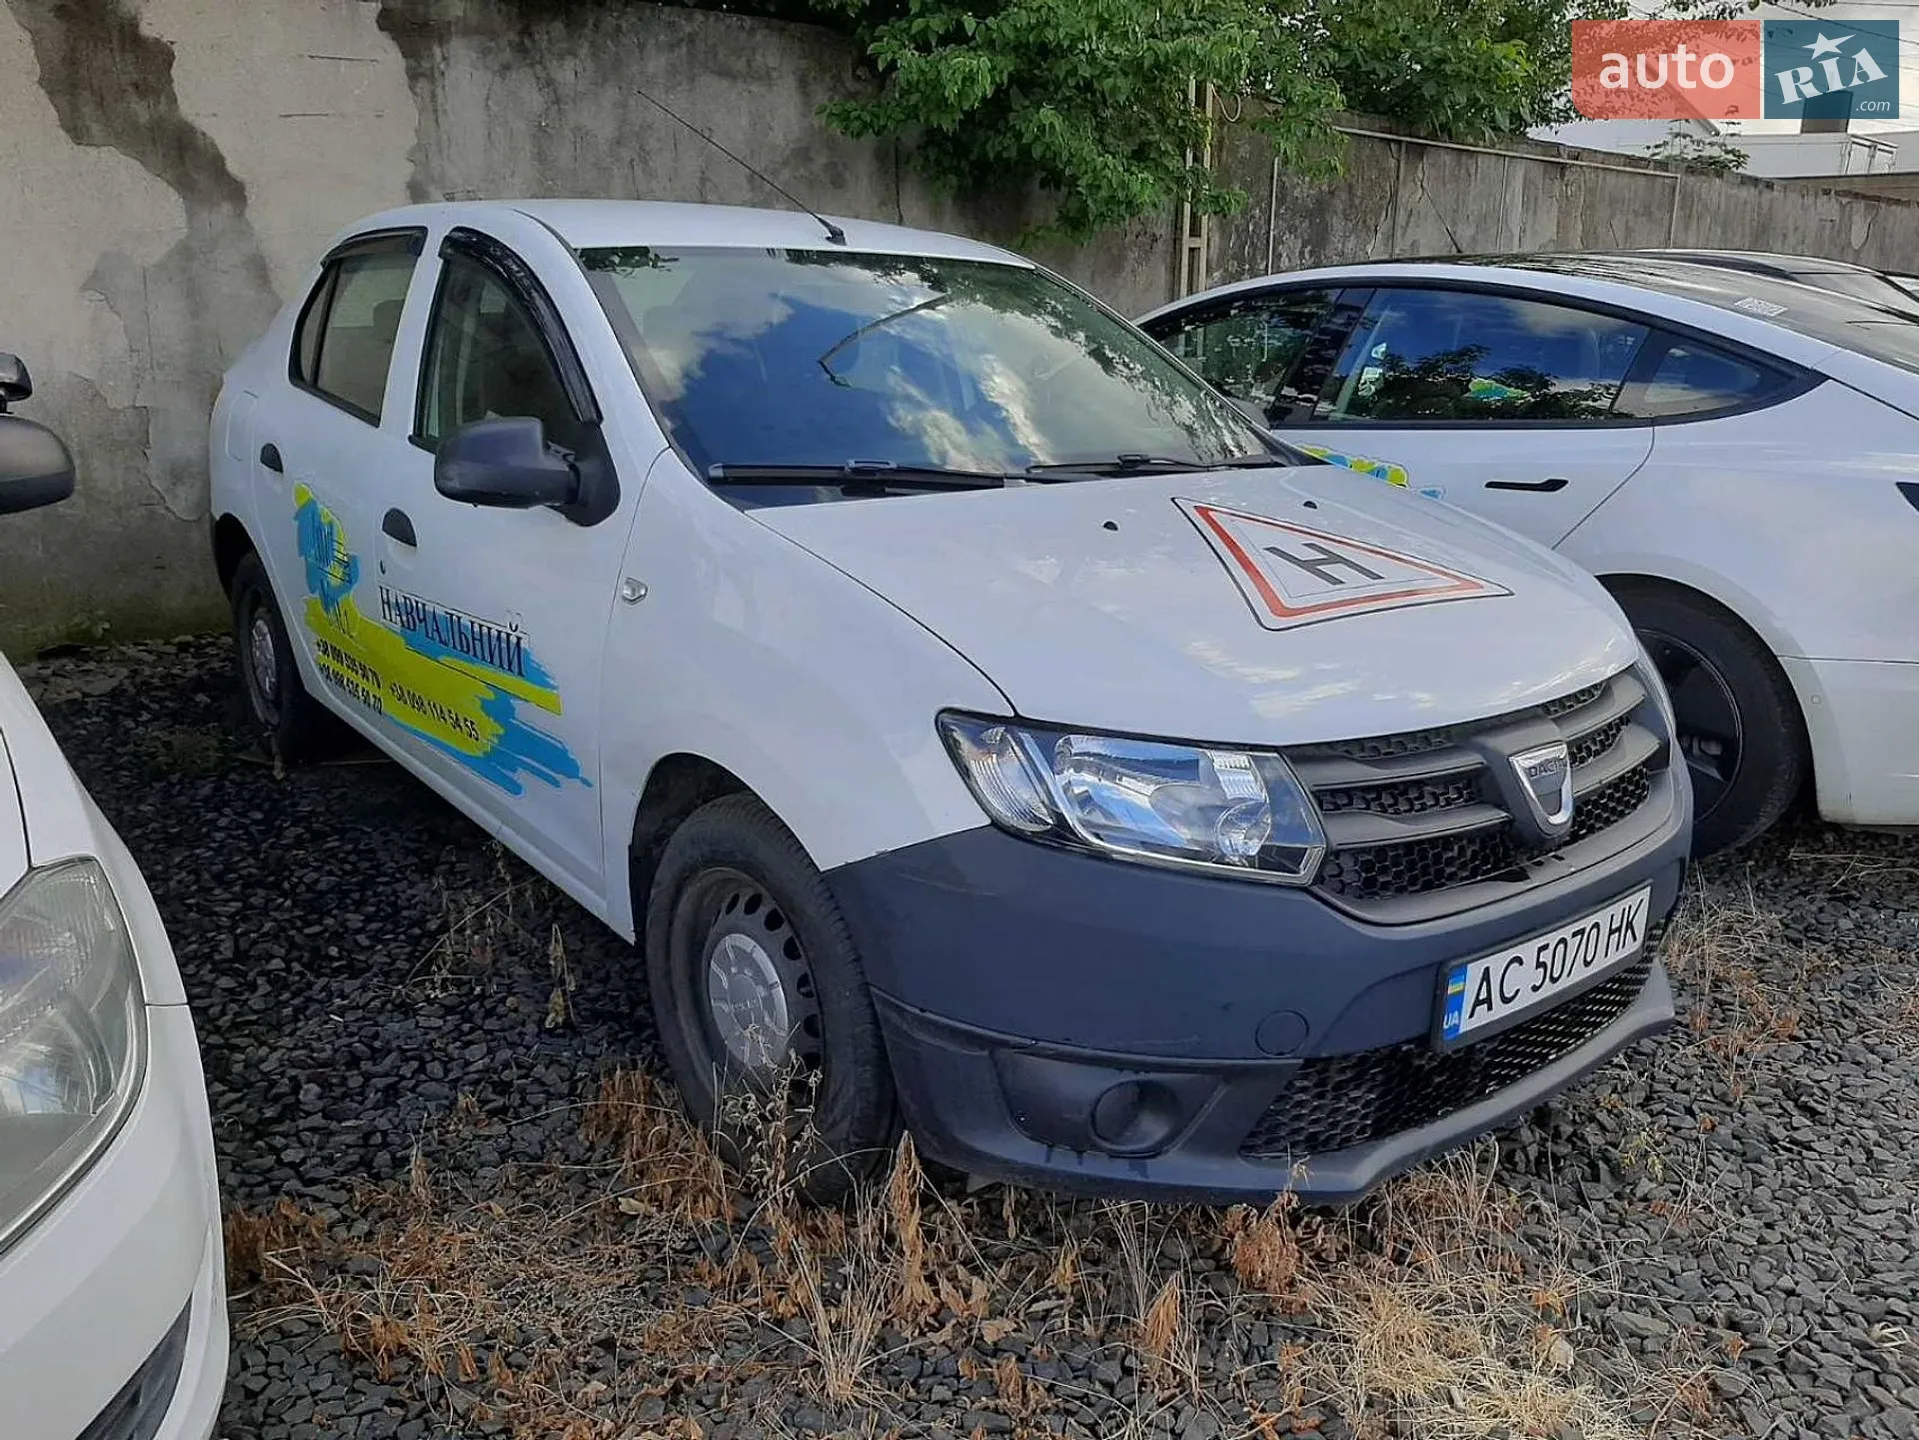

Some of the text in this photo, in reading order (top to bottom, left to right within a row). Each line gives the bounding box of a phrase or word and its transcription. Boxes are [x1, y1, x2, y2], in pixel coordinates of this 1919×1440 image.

[379, 585, 525, 677] НАВЧАЛЬНИЙ
[463, 716, 480, 742] 55
[1468, 898, 1644, 1019] AC 5070 HK
[1443, 1010, 1460, 1030] UA
